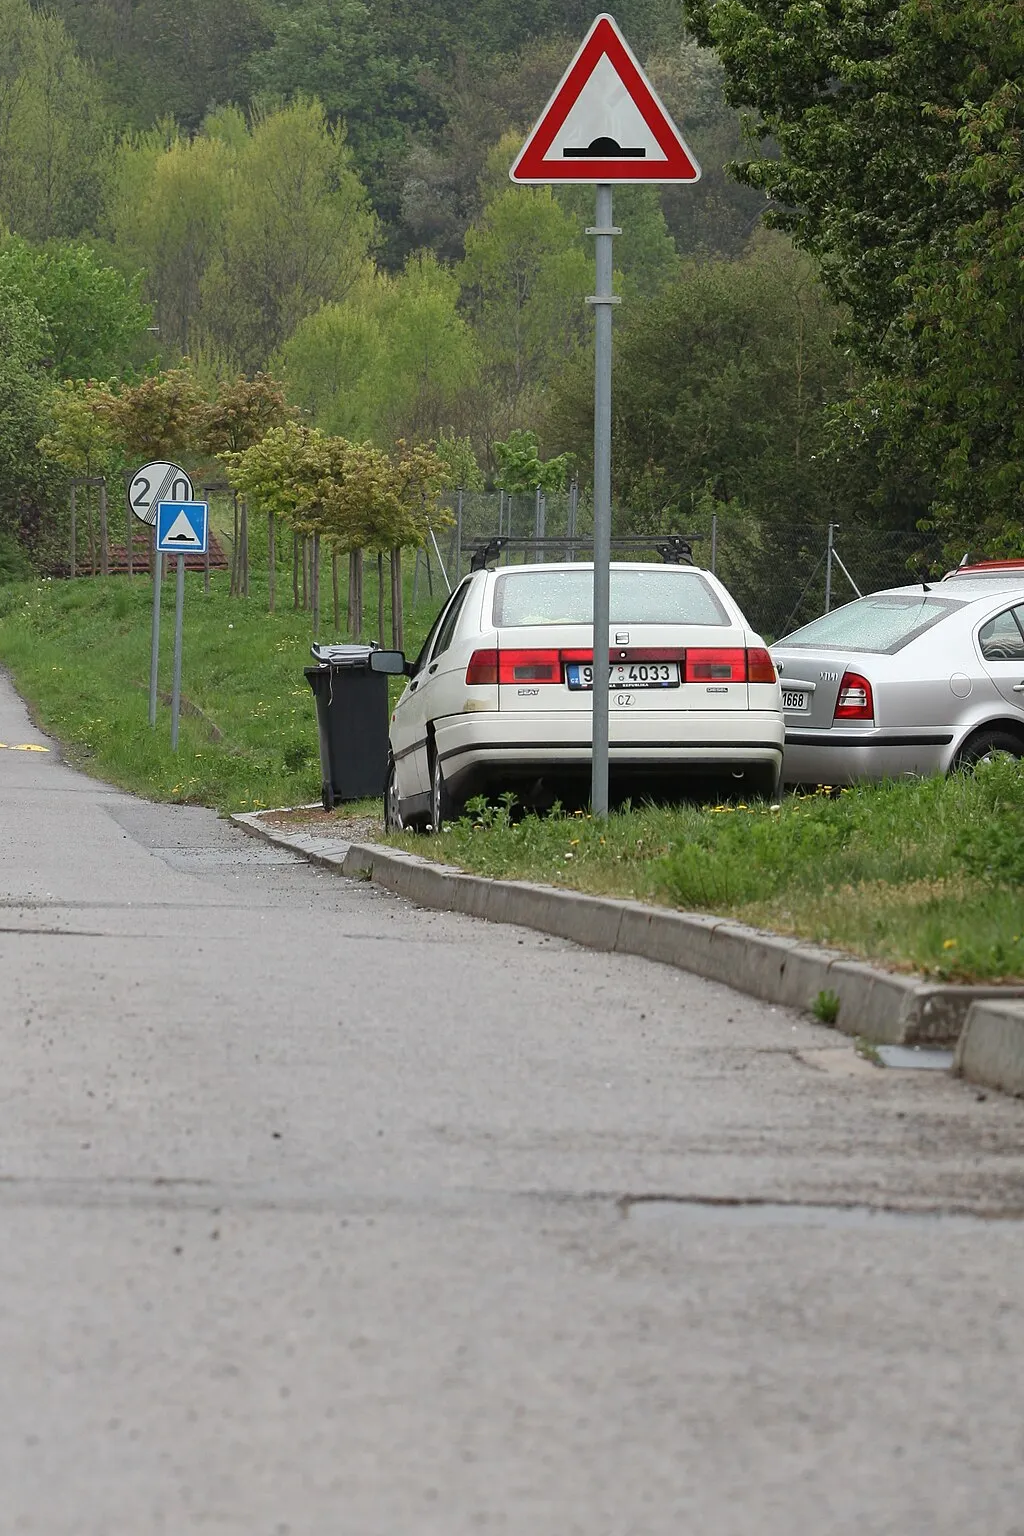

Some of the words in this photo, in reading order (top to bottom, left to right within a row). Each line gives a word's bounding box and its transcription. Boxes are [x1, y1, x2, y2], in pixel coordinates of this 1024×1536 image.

[628, 665, 670, 681] 4033
[517, 688, 540, 696] SEAT
[617, 694, 632, 706] CZ
[782, 692, 804, 708] 1668
